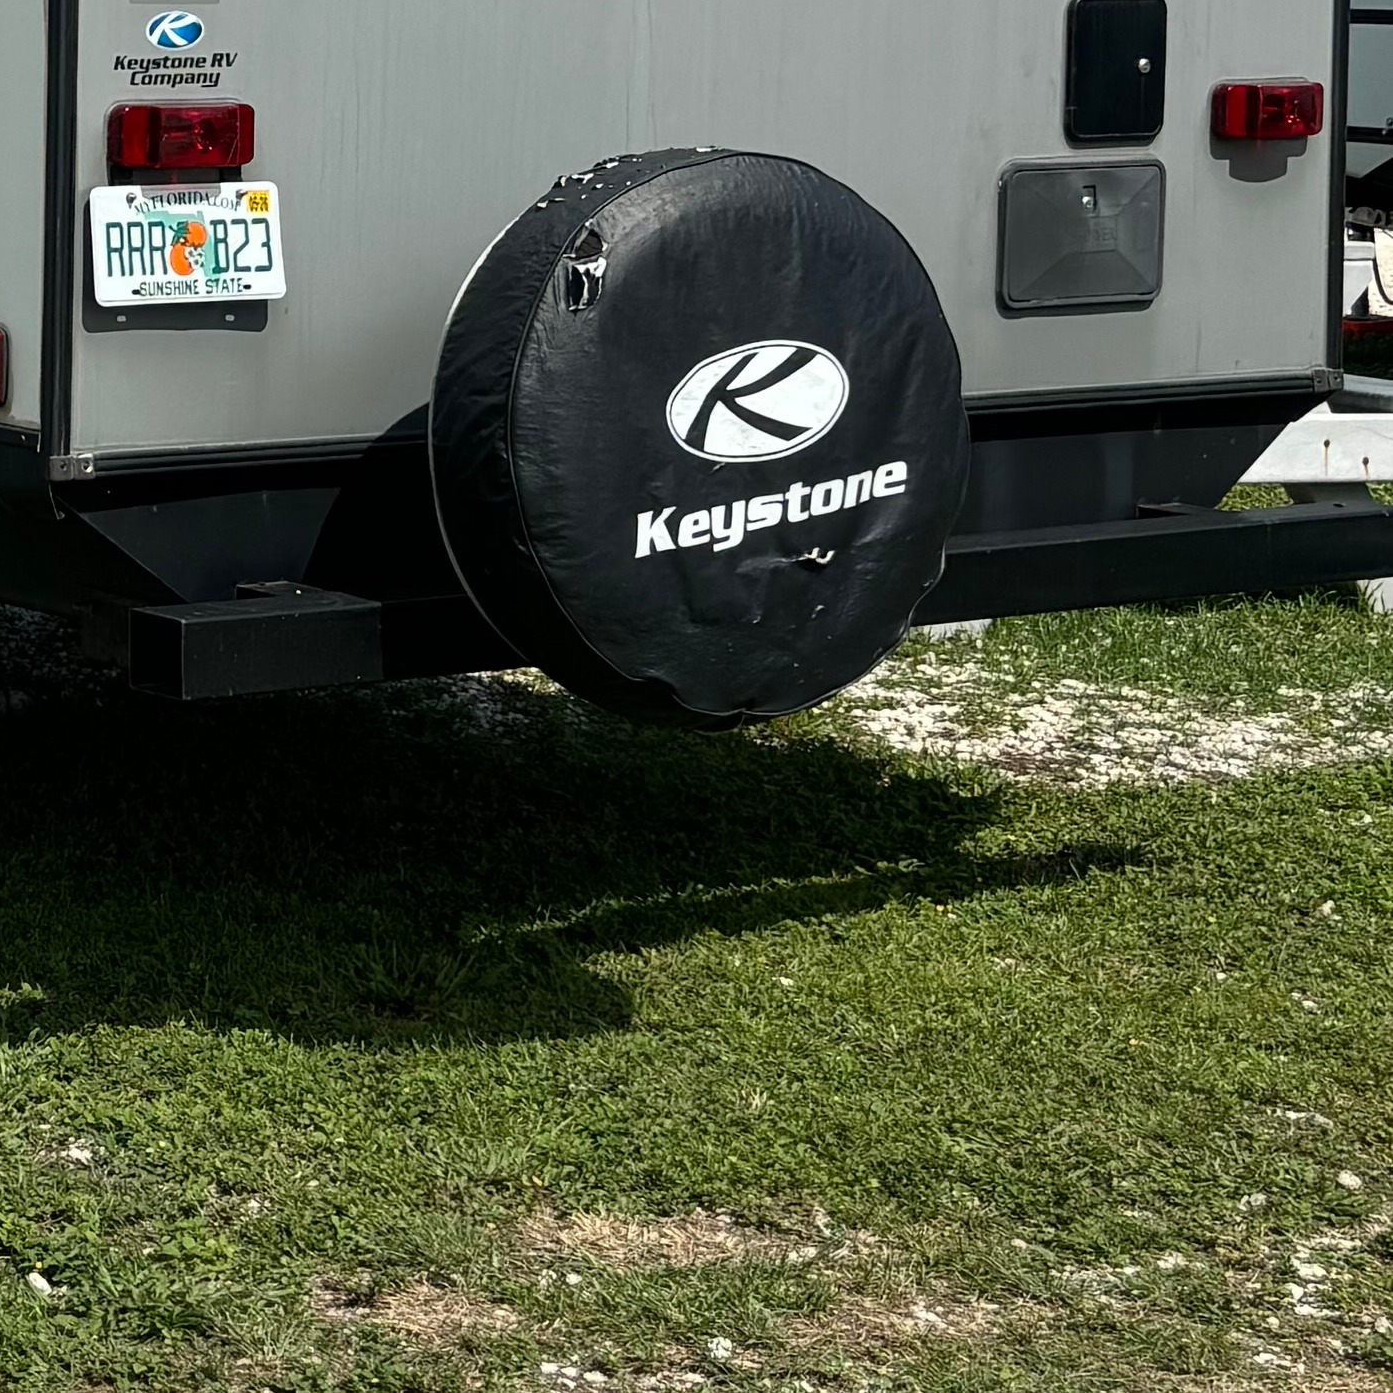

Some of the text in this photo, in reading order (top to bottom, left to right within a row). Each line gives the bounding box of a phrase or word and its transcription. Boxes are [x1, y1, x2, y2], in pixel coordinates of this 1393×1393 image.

[114, 52, 238, 73] Keystone RV
[130, 71, 220, 88] Company
[209, 217, 273, 275] B23
[139, 277, 244, 297] SUNSHINE STATE
[634, 461, 908, 559] Keystone
